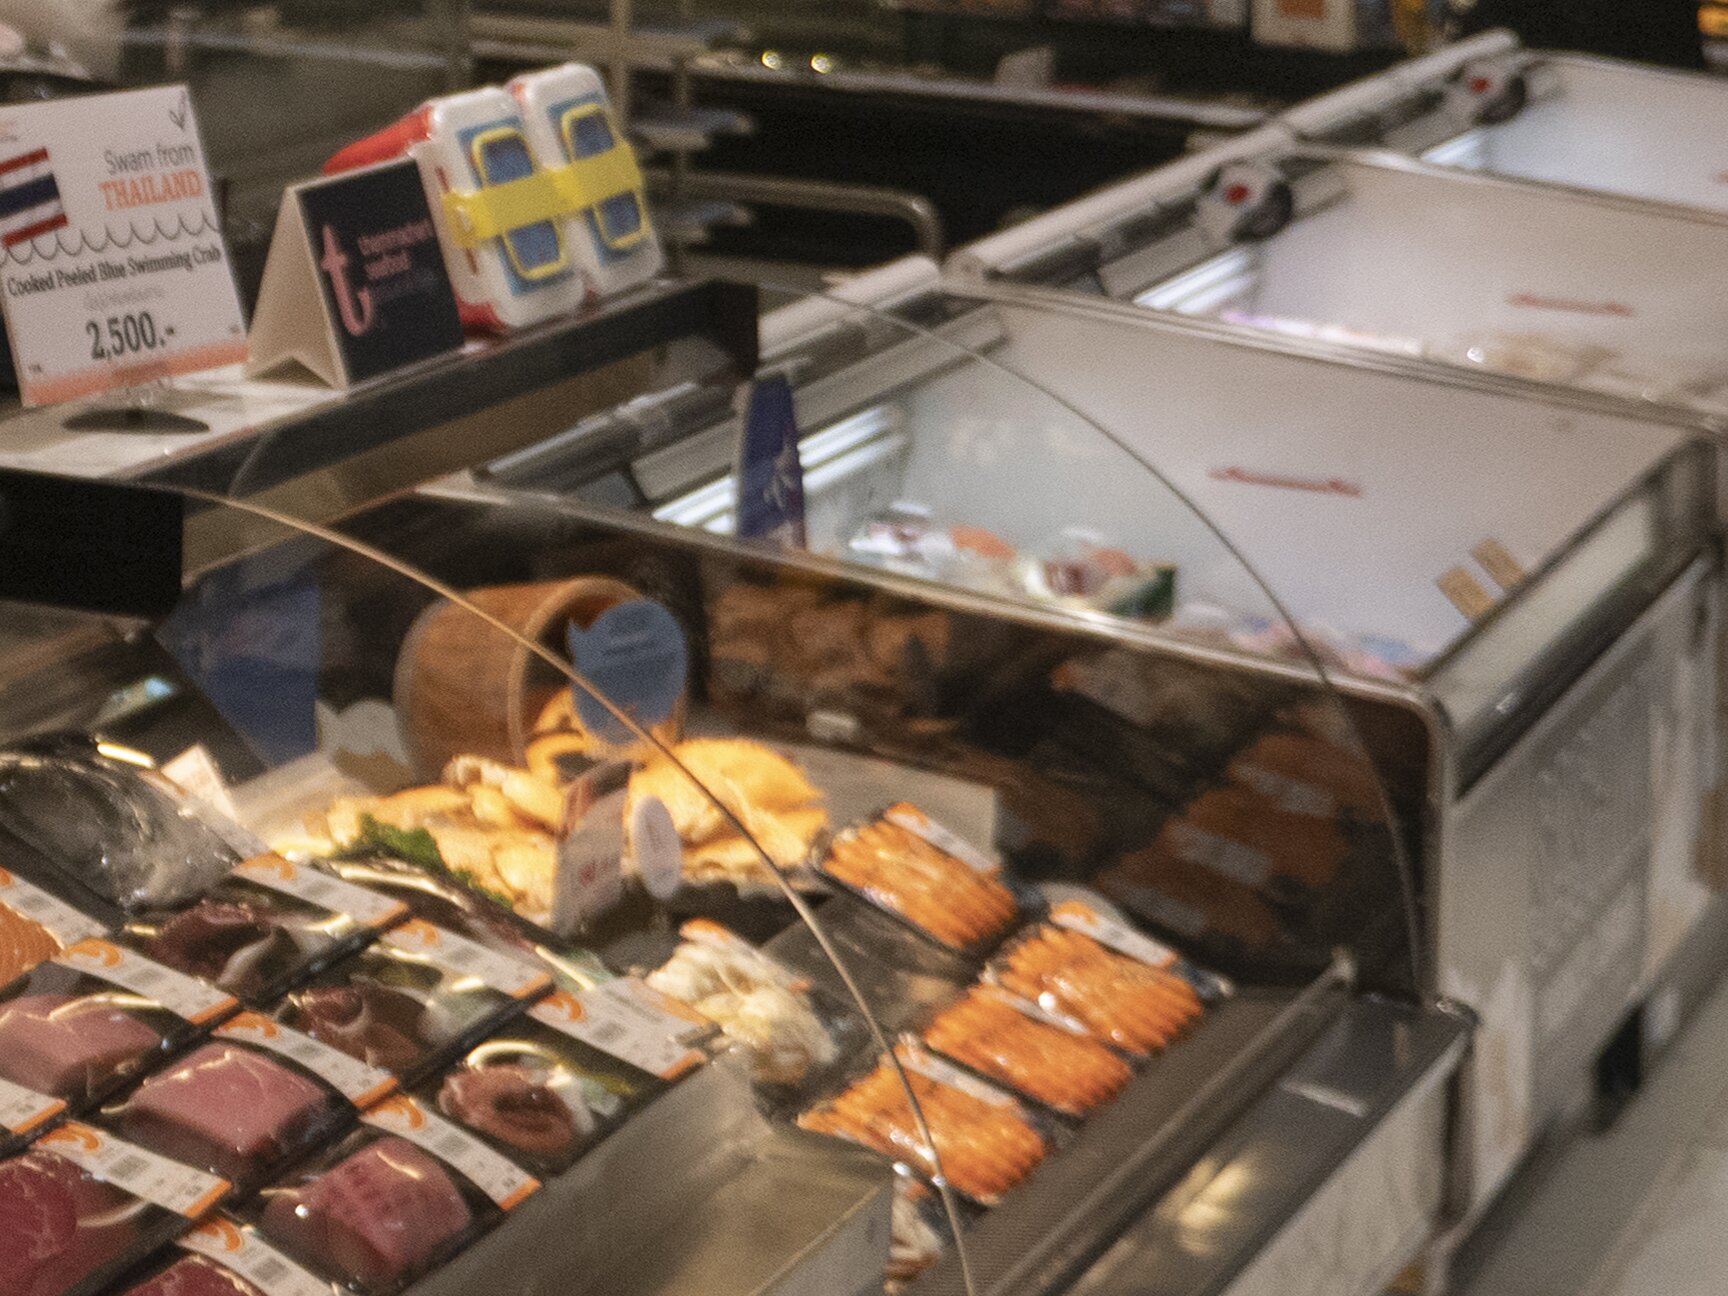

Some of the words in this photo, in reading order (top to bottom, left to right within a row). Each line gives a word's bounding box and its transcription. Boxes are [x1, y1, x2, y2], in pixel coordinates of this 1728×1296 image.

[103, 149, 154, 176] Swam
[156, 142, 195, 167] from
[99, 168, 203, 210] THAILAND
[7, 271, 55, 297] Cooked
[97, 260, 128, 282] Blue
[192, 243, 222, 266] Crab
[85, 310, 177, 361] 2,500.-
